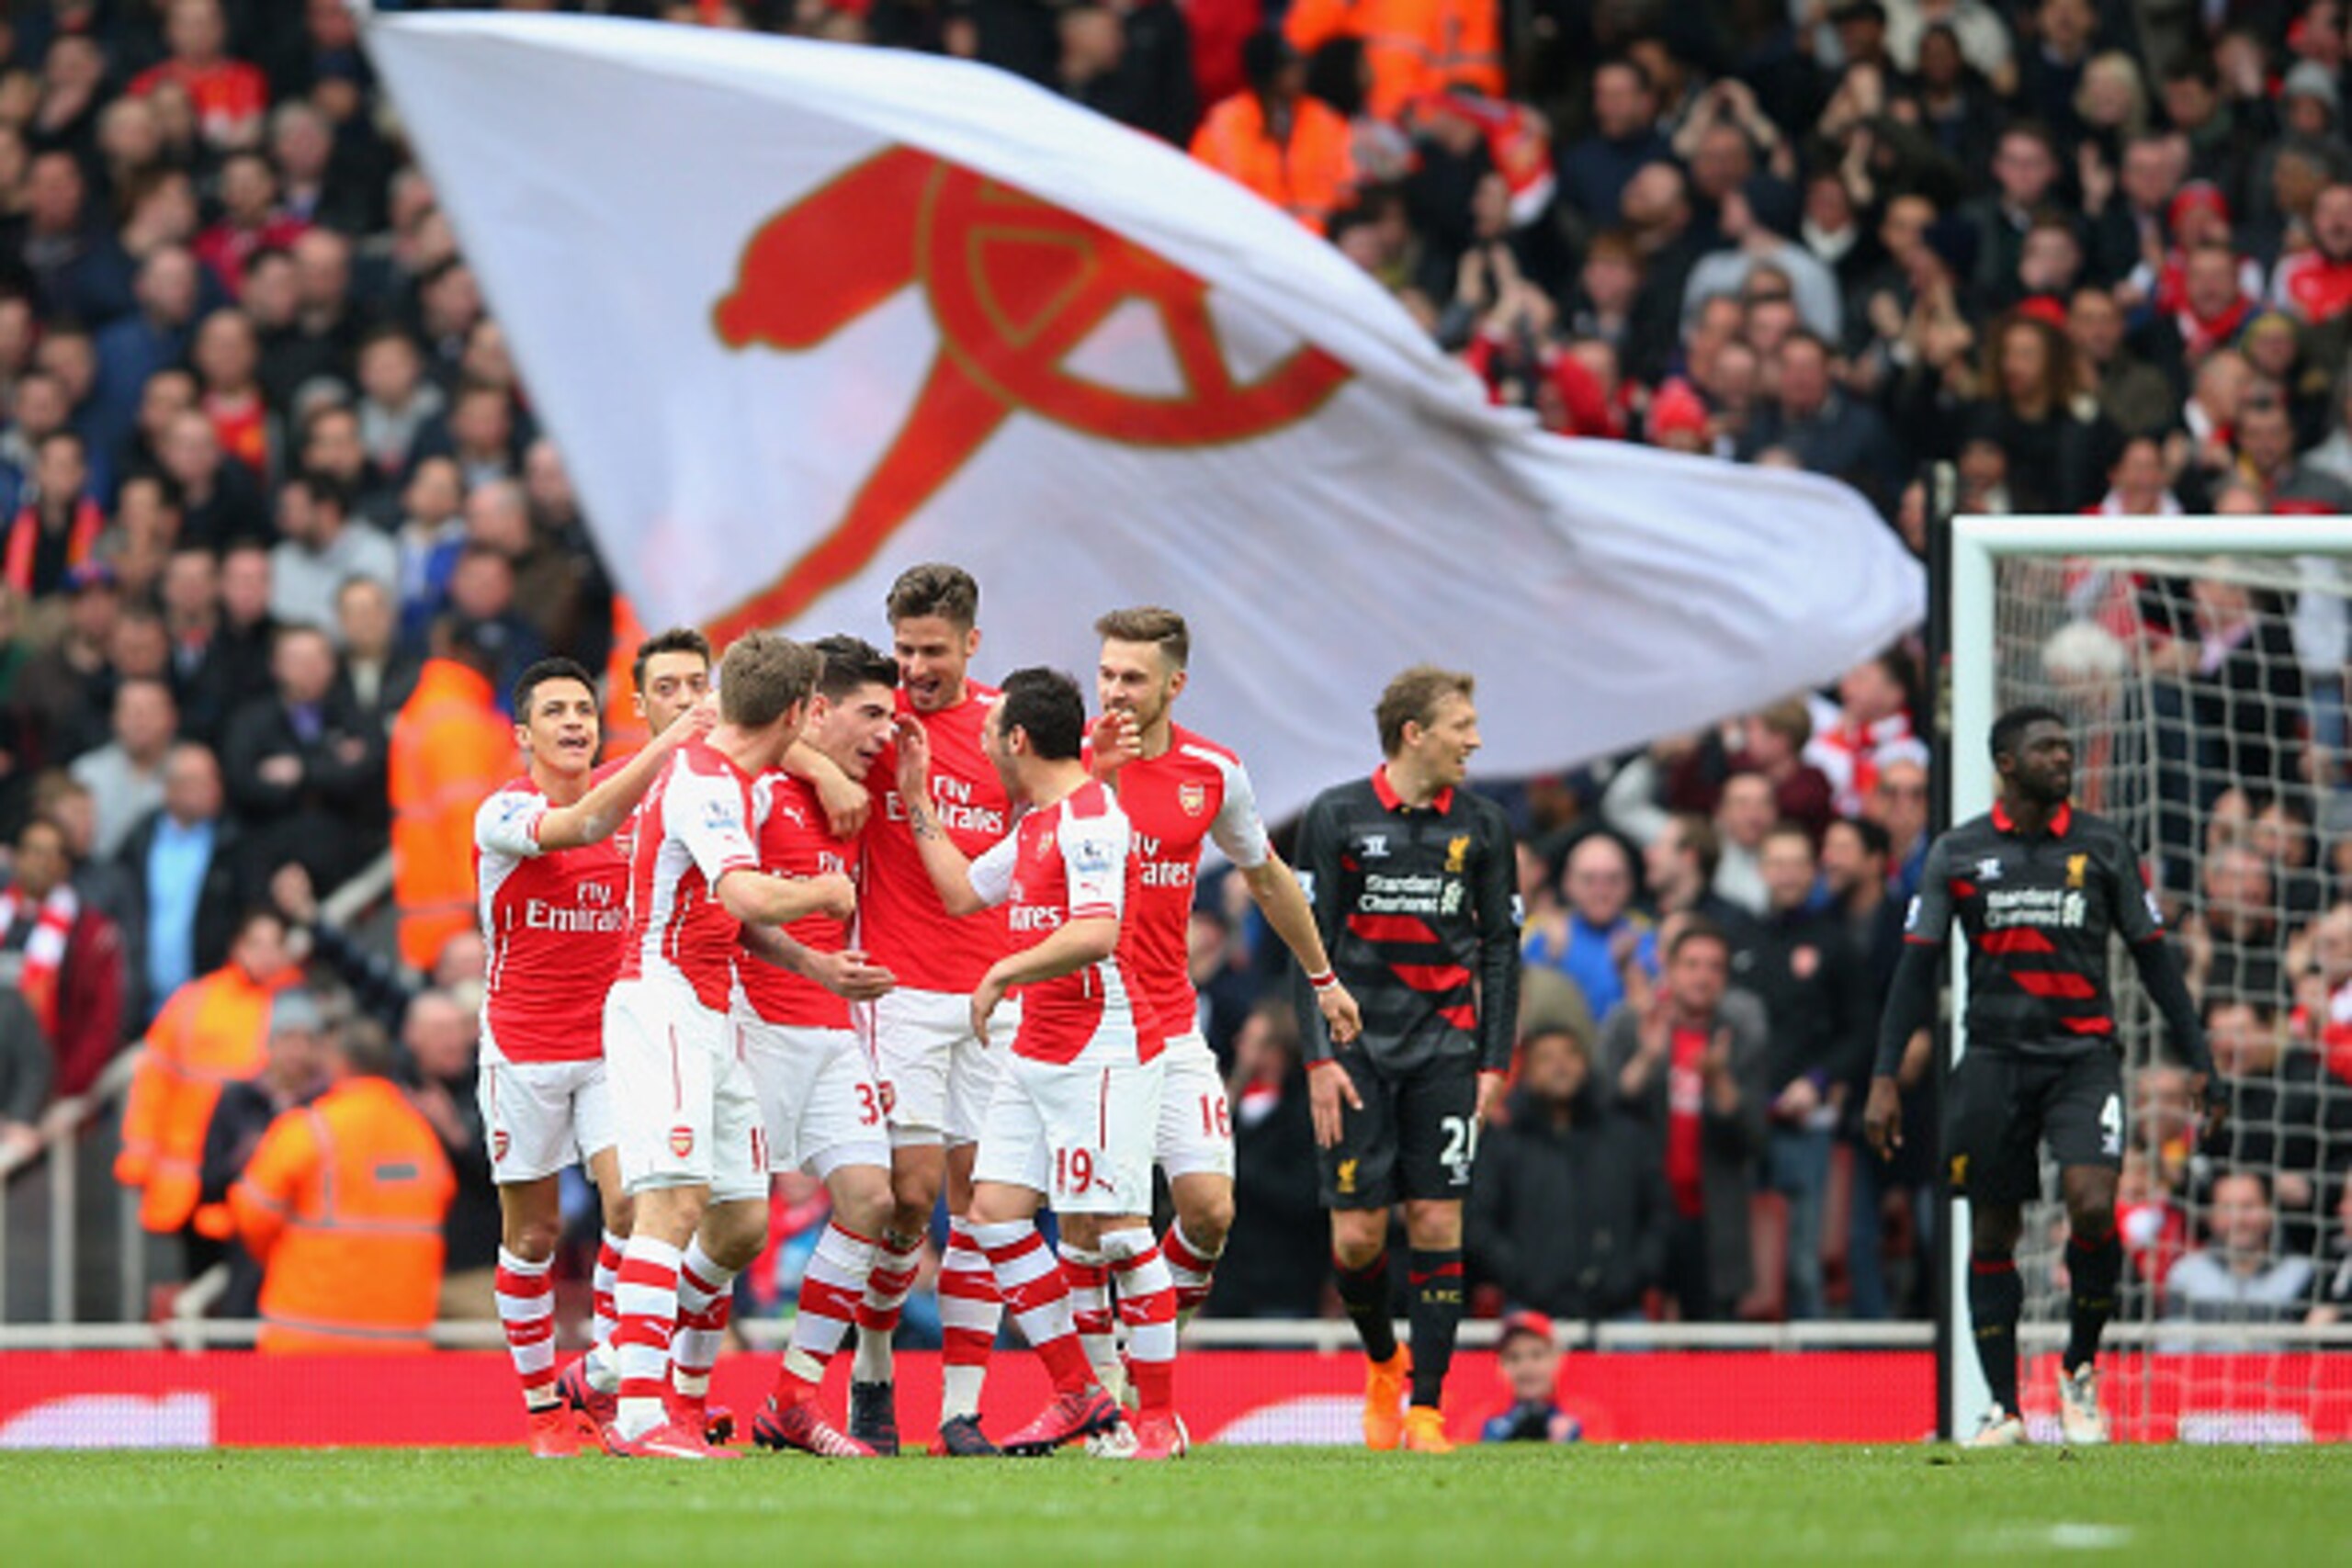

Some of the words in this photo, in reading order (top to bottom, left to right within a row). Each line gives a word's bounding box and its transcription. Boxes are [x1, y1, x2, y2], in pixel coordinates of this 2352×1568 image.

[933, 775, 971, 805] Fly
[577, 882, 611, 908] Fly
[2099, 1093, 2122, 1134] 4
[1056, 1145, 1094, 1194] 19
